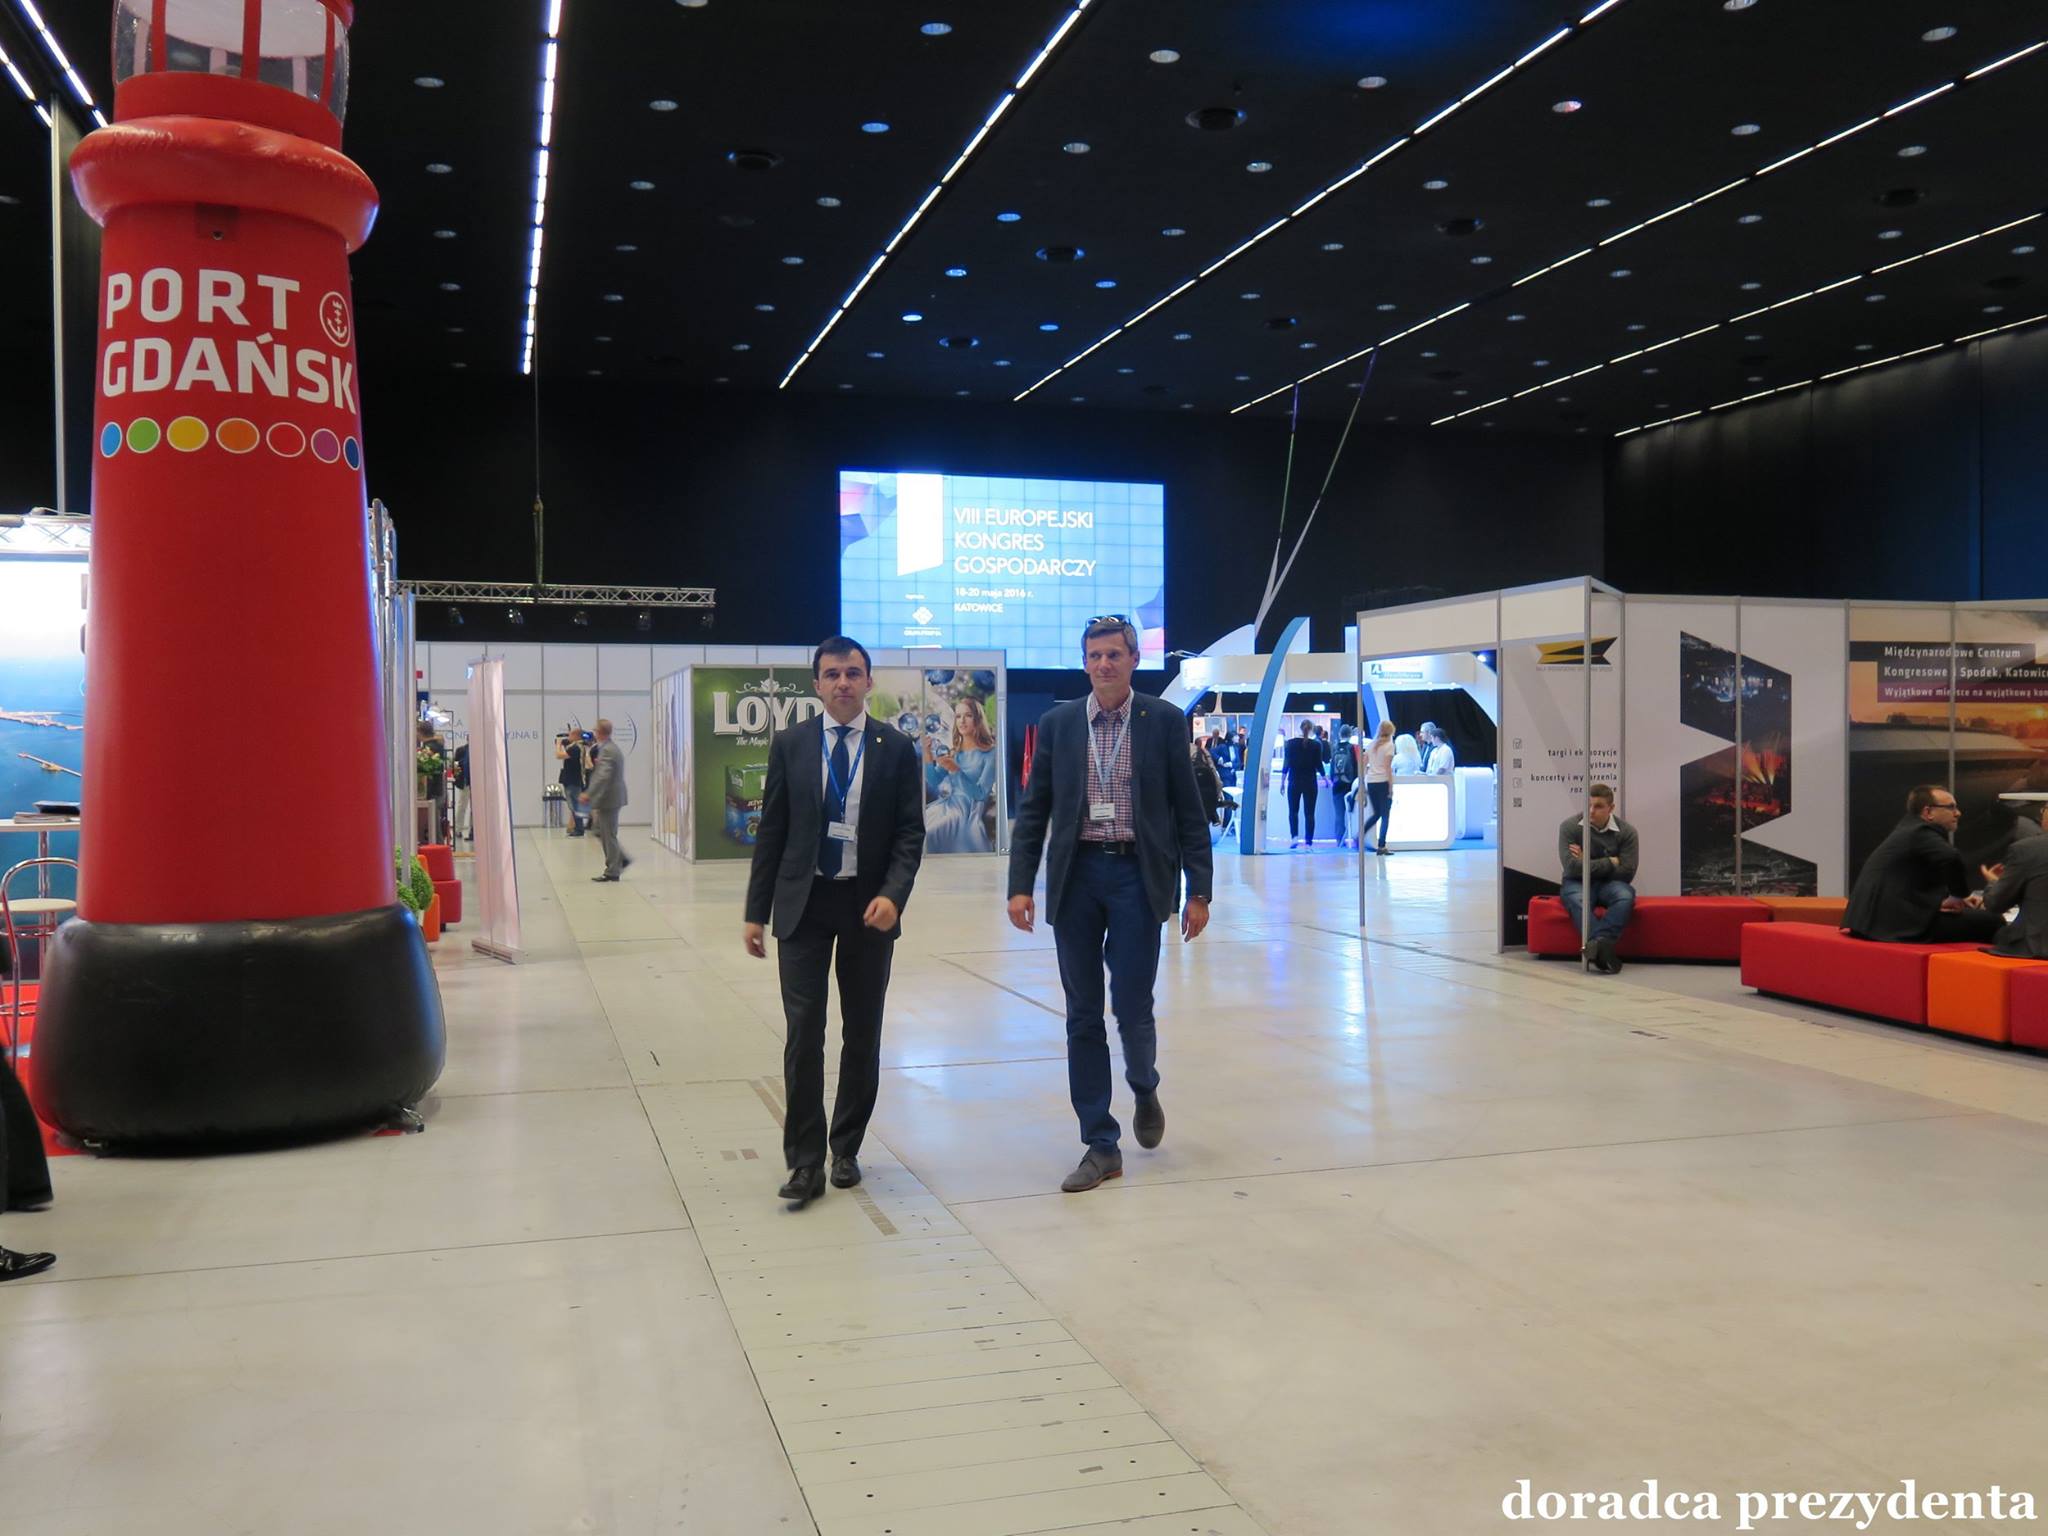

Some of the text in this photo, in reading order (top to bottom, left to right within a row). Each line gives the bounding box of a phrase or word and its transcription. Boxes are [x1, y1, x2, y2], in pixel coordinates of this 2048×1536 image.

[106, 267, 300, 330] PORT
[102, 332, 357, 415] GDAŃSK
[953, 507, 1094, 529] VIII EUROPEJSKI
[954, 532, 1044, 552] KONGRES
[954, 556, 1097, 577] GOSPODARCZY
[982, 588, 1002, 599] maja
[1004, 588, 1026, 598] 2016
[954, 602, 1004, 613] KATOWICE
[1977, 647, 2021, 658] Centrum
[1884, 666, 1948, 679] Kongresowe
[1960, 666, 2001, 679] Spodek,
[1884, 687, 1932, 698] Wyjątkowe
[1973, 689, 1983, 697] na
[1530, 773, 1565, 782] koncerty
